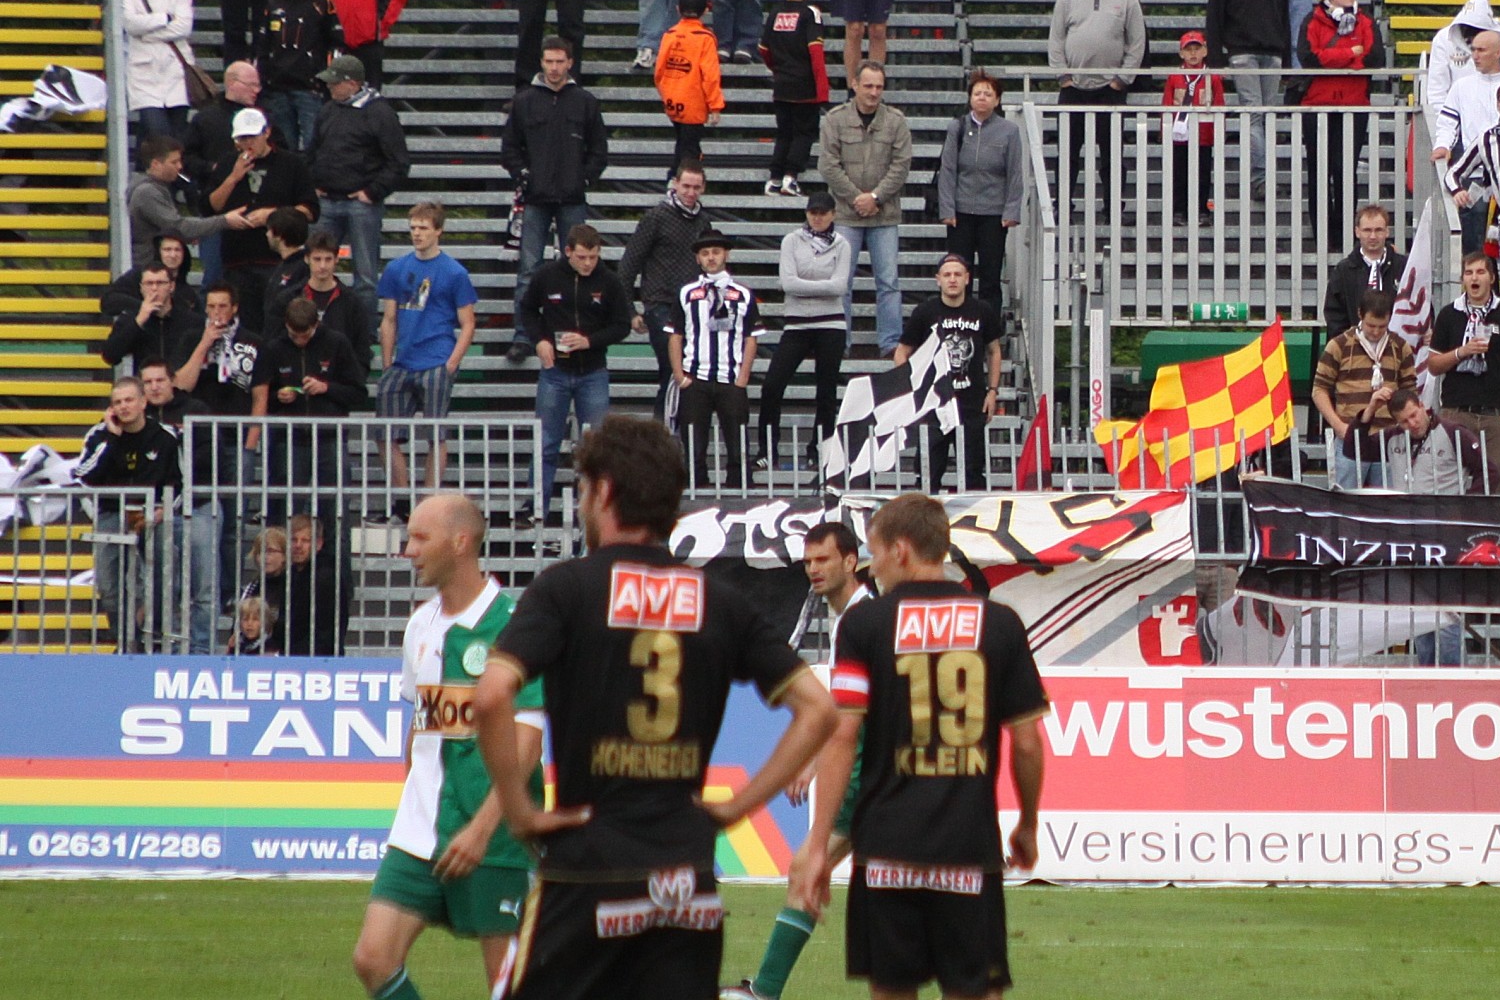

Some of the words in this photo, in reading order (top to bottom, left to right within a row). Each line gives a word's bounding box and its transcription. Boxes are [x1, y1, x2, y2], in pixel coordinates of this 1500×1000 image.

[1261, 524, 1448, 568] LINZER
[612, 583, 698, 618] AVE
[899, 612, 977, 641] AVE
[153, 669, 404, 702] MALERBET
[626, 629, 683, 743] 3
[895, 651, 986, 747] 19
[895, 746, 988, 777] KLEIN
[28, 832, 222, 859] 02631/2286
